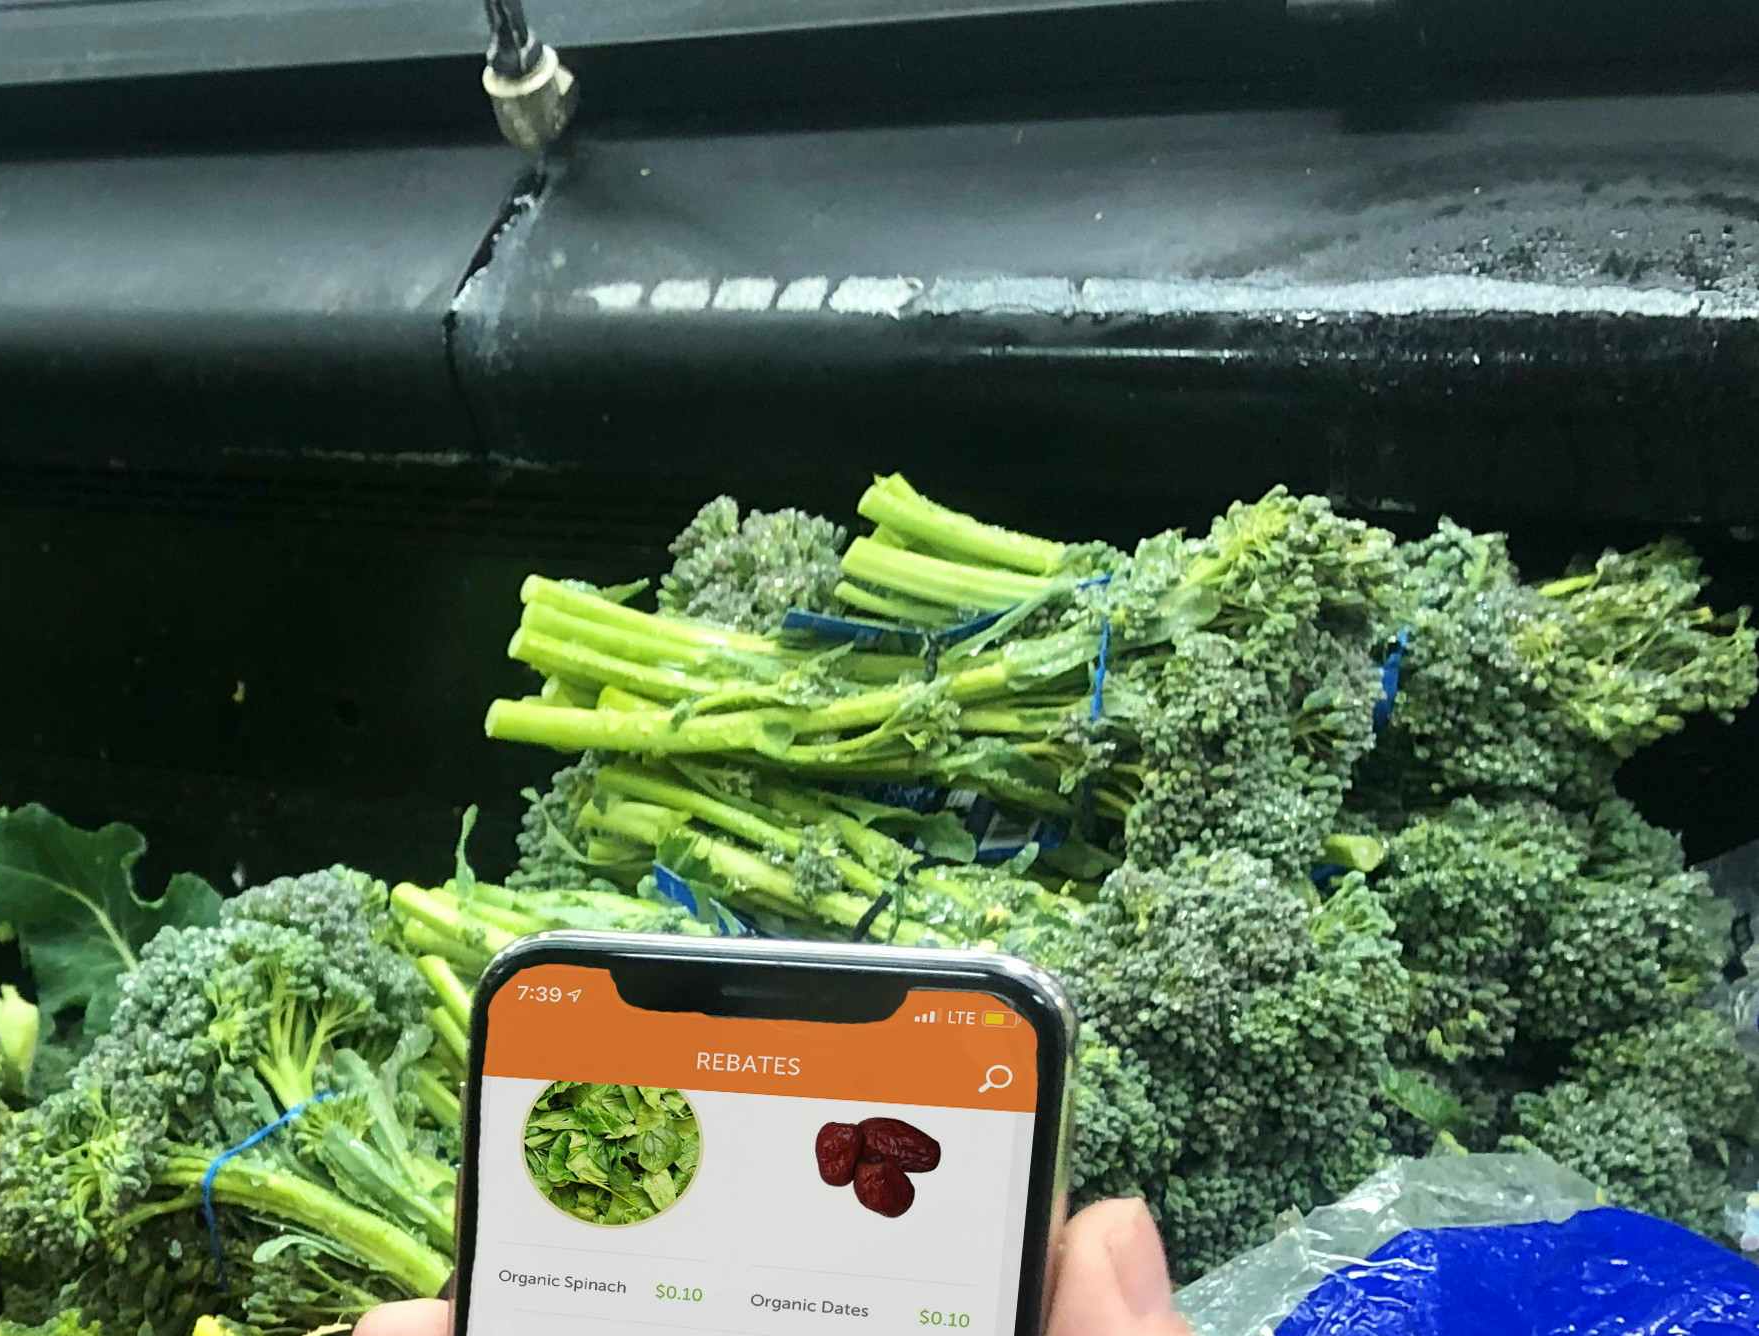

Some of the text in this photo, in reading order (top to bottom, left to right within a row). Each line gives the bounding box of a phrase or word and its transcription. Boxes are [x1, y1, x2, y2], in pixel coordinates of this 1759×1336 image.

[517, 985, 563, 1004] 7:39
[947, 1010, 977, 1026] LTE
[695, 1051, 802, 1077] REBATES
[498, 1269, 627, 1294] Organic Spinach
[655, 1282, 704, 1304] $0.10
[750, 1293, 869, 1318] Organic Dates
[918, 1308, 971, 1330] $0.10
